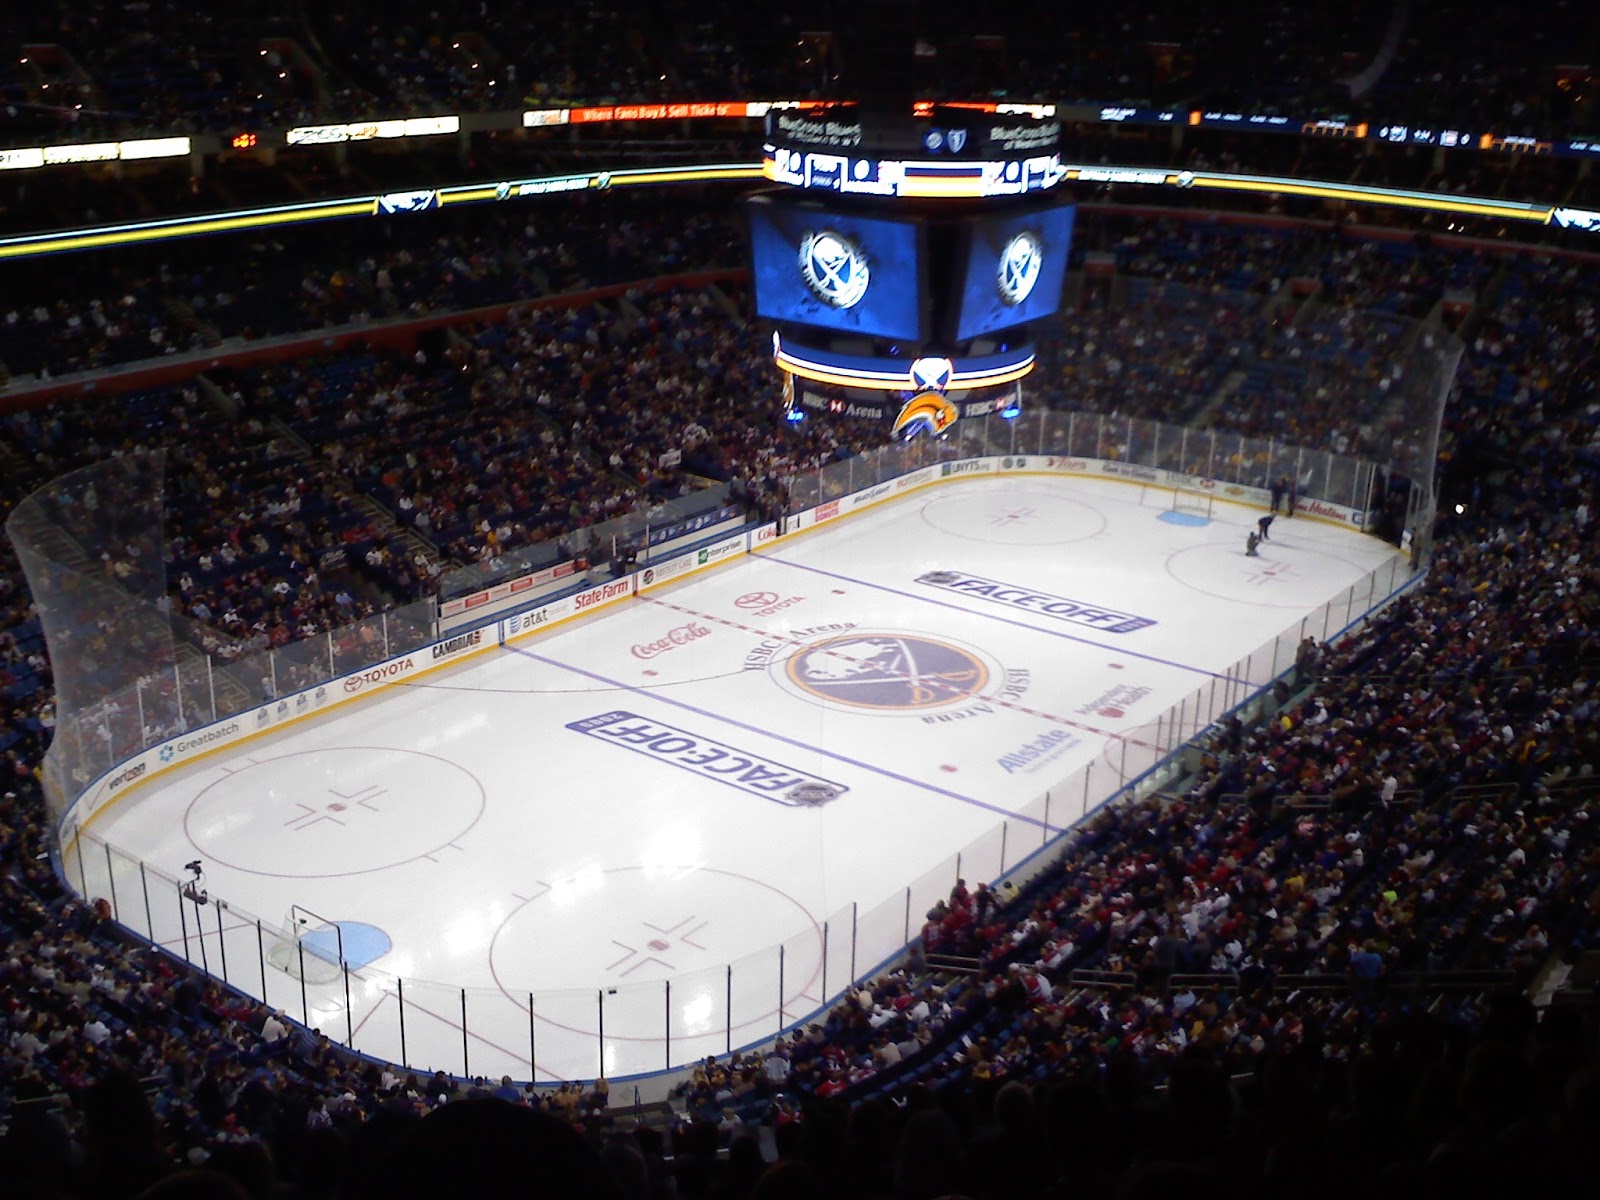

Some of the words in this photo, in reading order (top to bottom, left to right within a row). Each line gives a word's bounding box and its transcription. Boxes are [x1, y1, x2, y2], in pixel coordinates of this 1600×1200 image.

[583, 107, 613, 121] Where
[614, 105, 638, 119] Fans
[639, 105, 659, 119] Buy
[845, 404, 882, 418] Arena
[574, 592, 601, 610] State
[602, 581, 628, 600] Farm
[752, 596, 806, 617] TOYOTA
[523, 608, 548, 628] at&t
[631, 622, 711, 659] Coca-Cola
[744, 640, 782, 671] HSBC
[789, 621, 858, 638] Arena
[364, 658, 414, 682] TOYOTA
[1004, 668, 1031, 702] HSBC
[922, 704, 994, 724] Arena
[176, 722, 239, 752] Greatbatch
[997, 729, 1072, 774] Allstate
[109, 761, 146, 789] verizon
